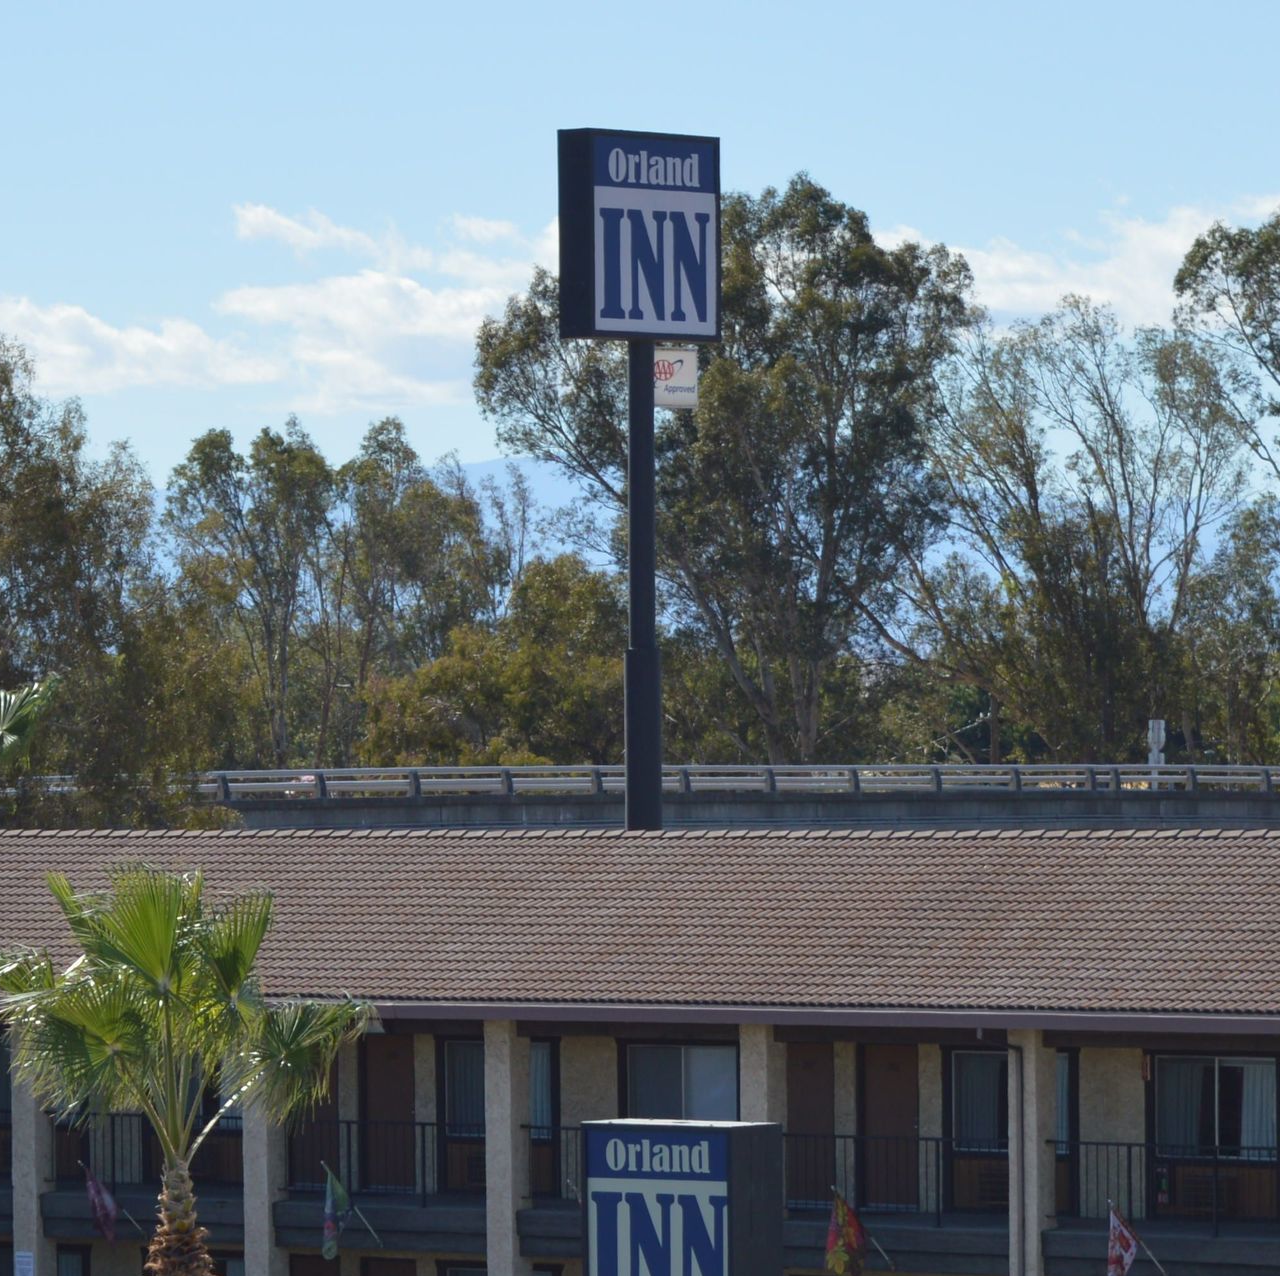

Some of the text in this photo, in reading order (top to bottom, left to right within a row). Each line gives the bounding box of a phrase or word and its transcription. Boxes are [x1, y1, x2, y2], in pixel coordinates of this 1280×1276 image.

[608, 148, 700, 187] Orland
[599, 208, 710, 322] INN
[664, 384, 695, 395] Approved
[605, 1138, 710, 1173] Orland
